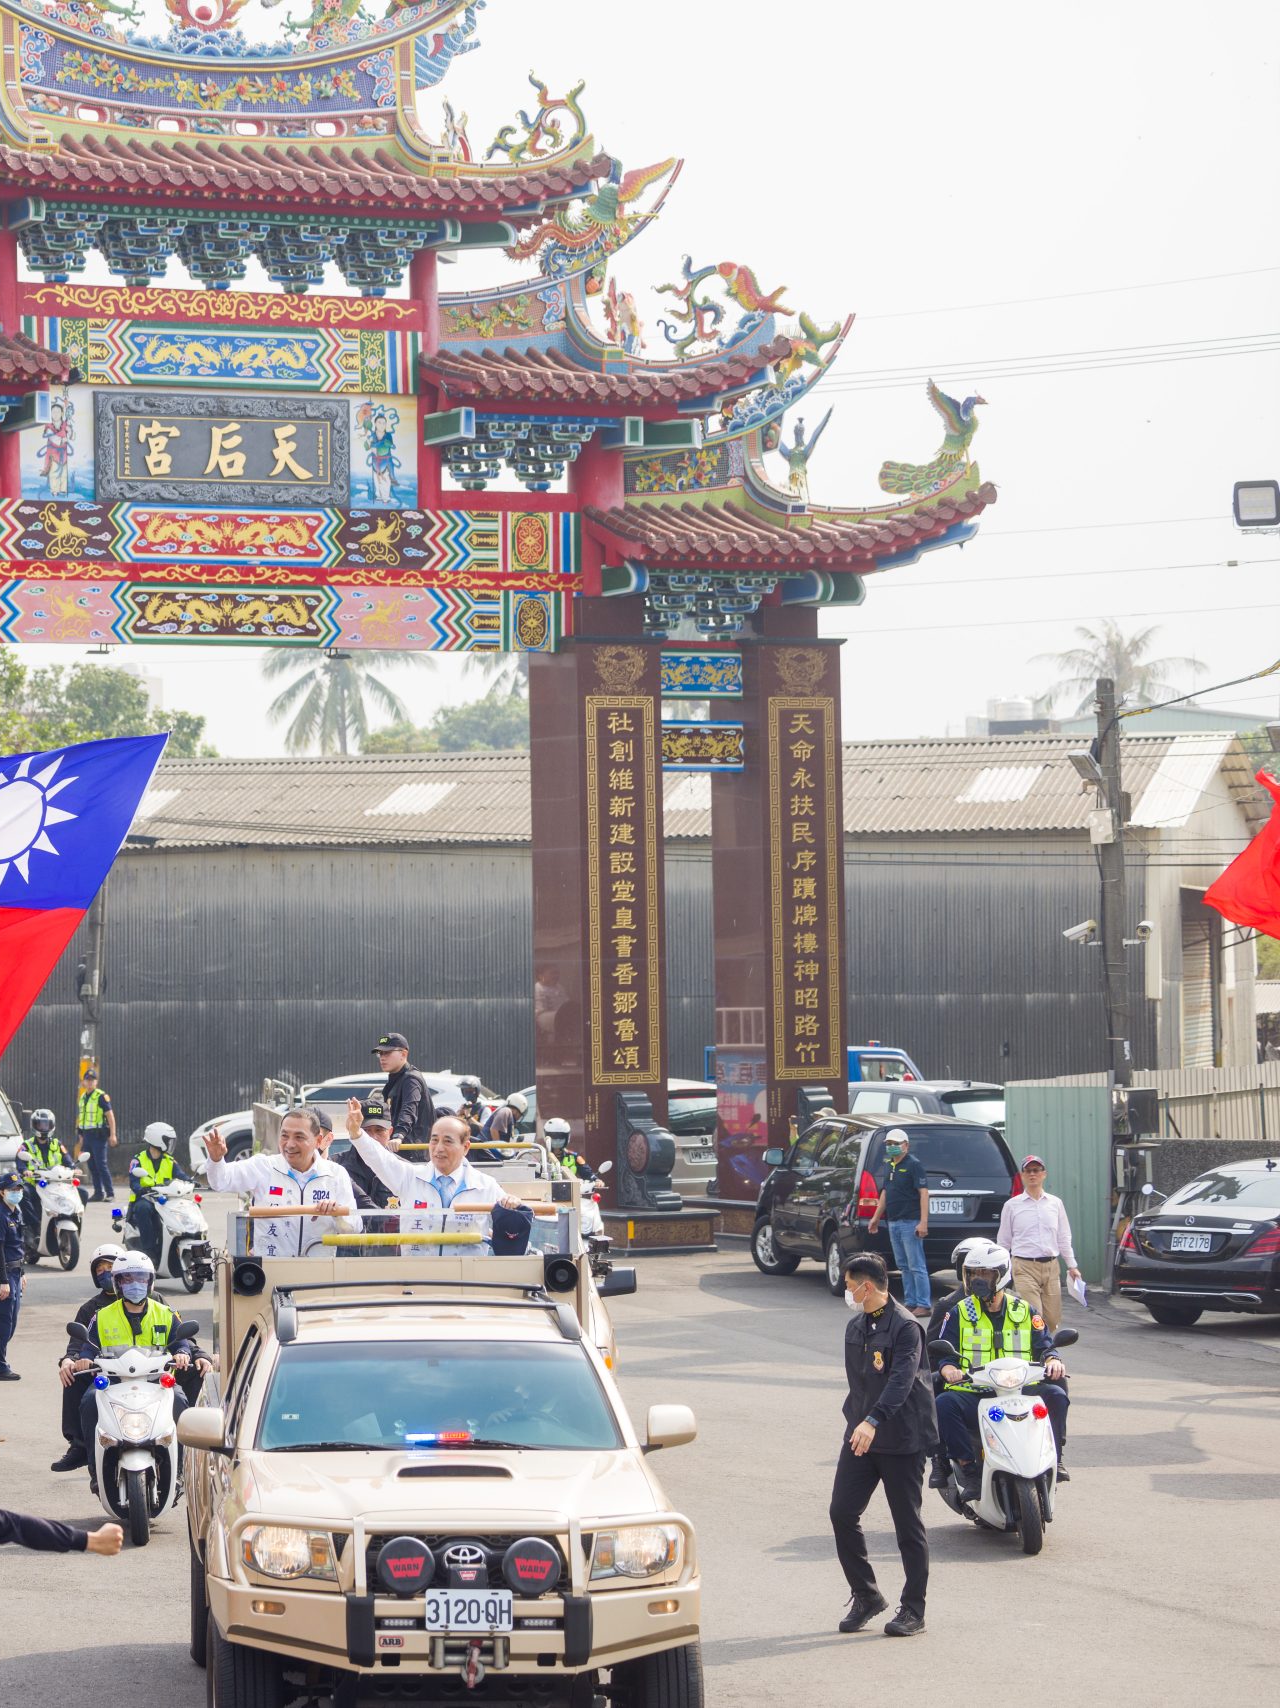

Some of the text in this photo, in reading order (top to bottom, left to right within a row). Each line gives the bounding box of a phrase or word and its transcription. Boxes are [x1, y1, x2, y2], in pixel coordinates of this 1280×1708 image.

[138, 419, 314, 480] 天后宮
[312, 1190, 330, 1201] 2024
[393, 1563, 420, 1572] WARN
[519, 1564, 547, 1574] WARN
[381, 1637, 402, 1646] ARB
